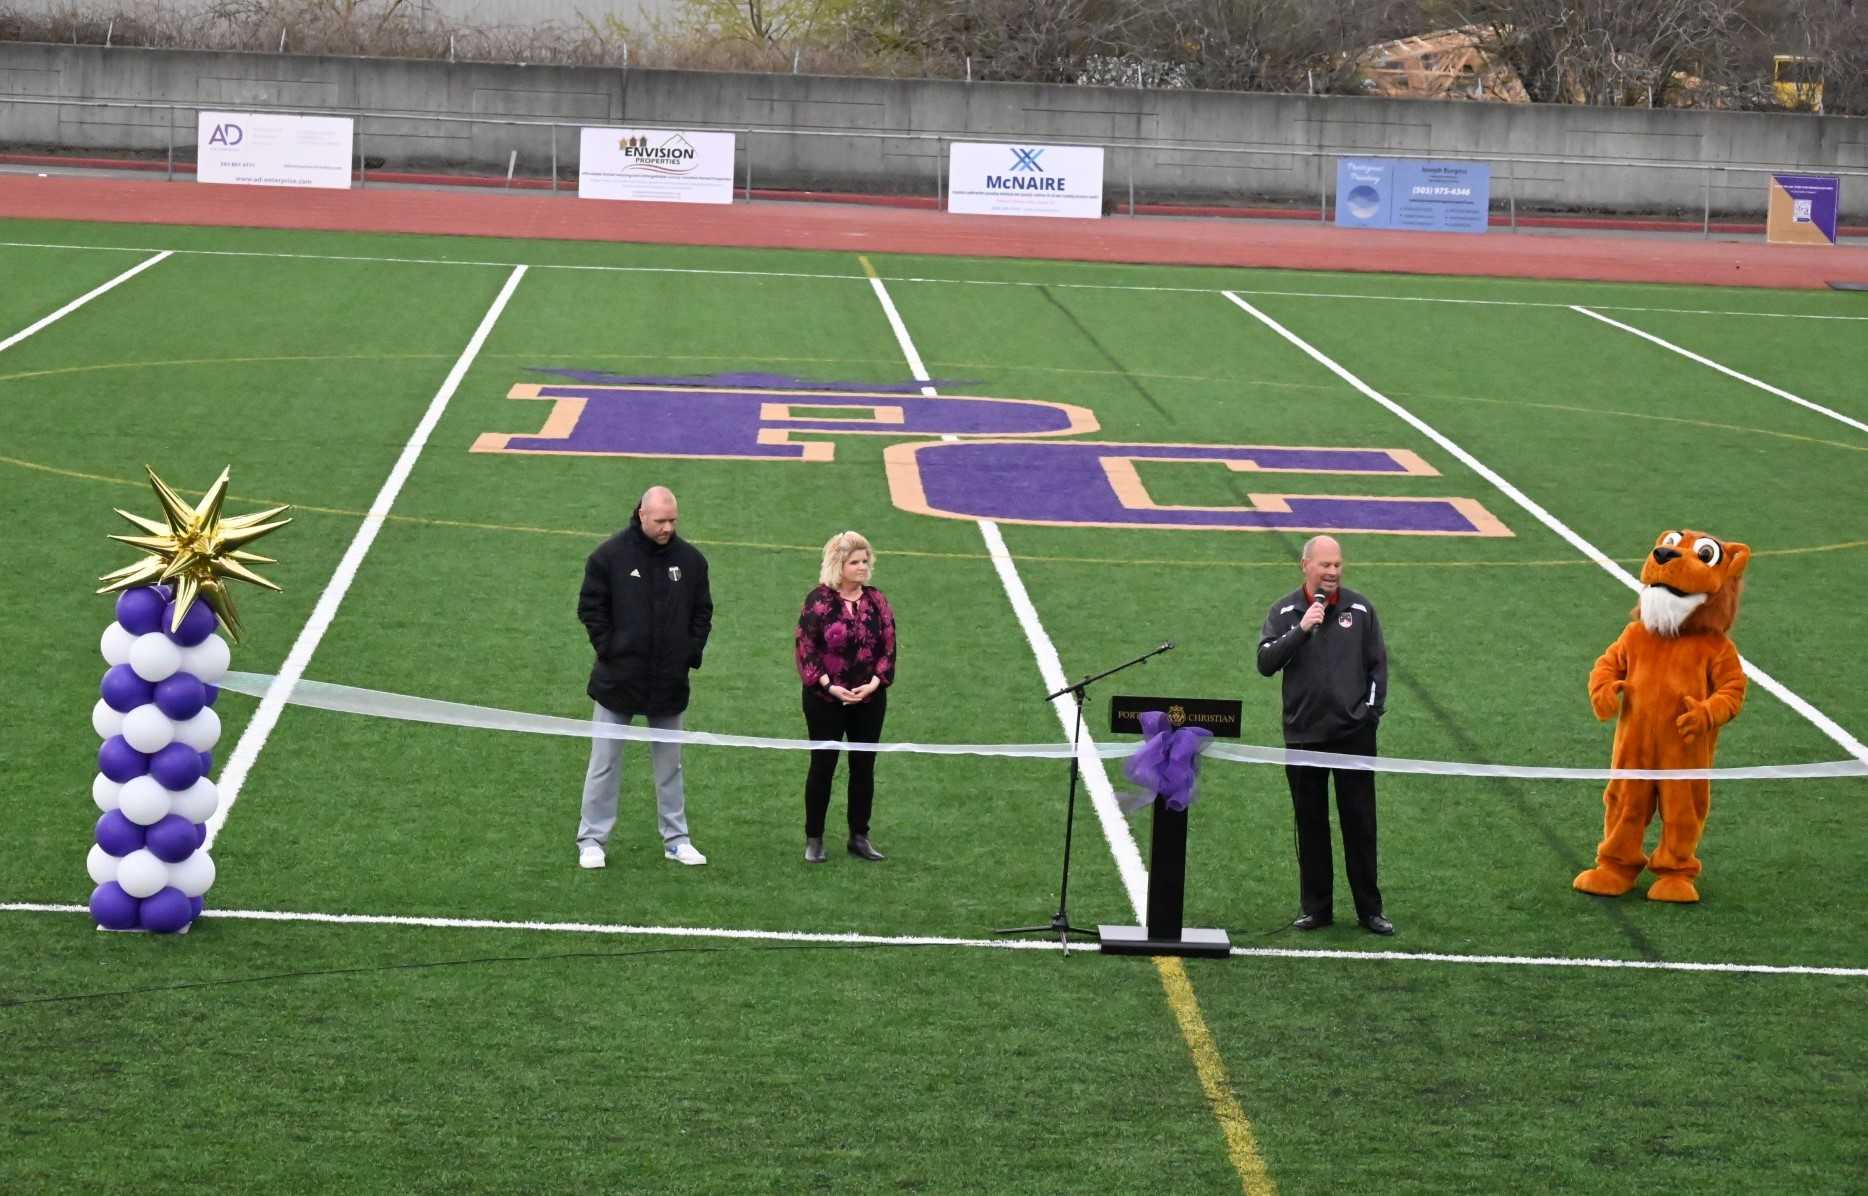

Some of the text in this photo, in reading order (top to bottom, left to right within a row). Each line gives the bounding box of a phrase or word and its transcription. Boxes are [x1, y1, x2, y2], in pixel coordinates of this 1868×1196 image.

[208, 124, 244, 146] AD
[625, 147, 695, 159] ENVISION
[635, 157, 681, 165] PROPERTIES
[986, 175, 1066, 191] McNAIRE
[1189, 714, 1236, 723] CHRISTIAN
